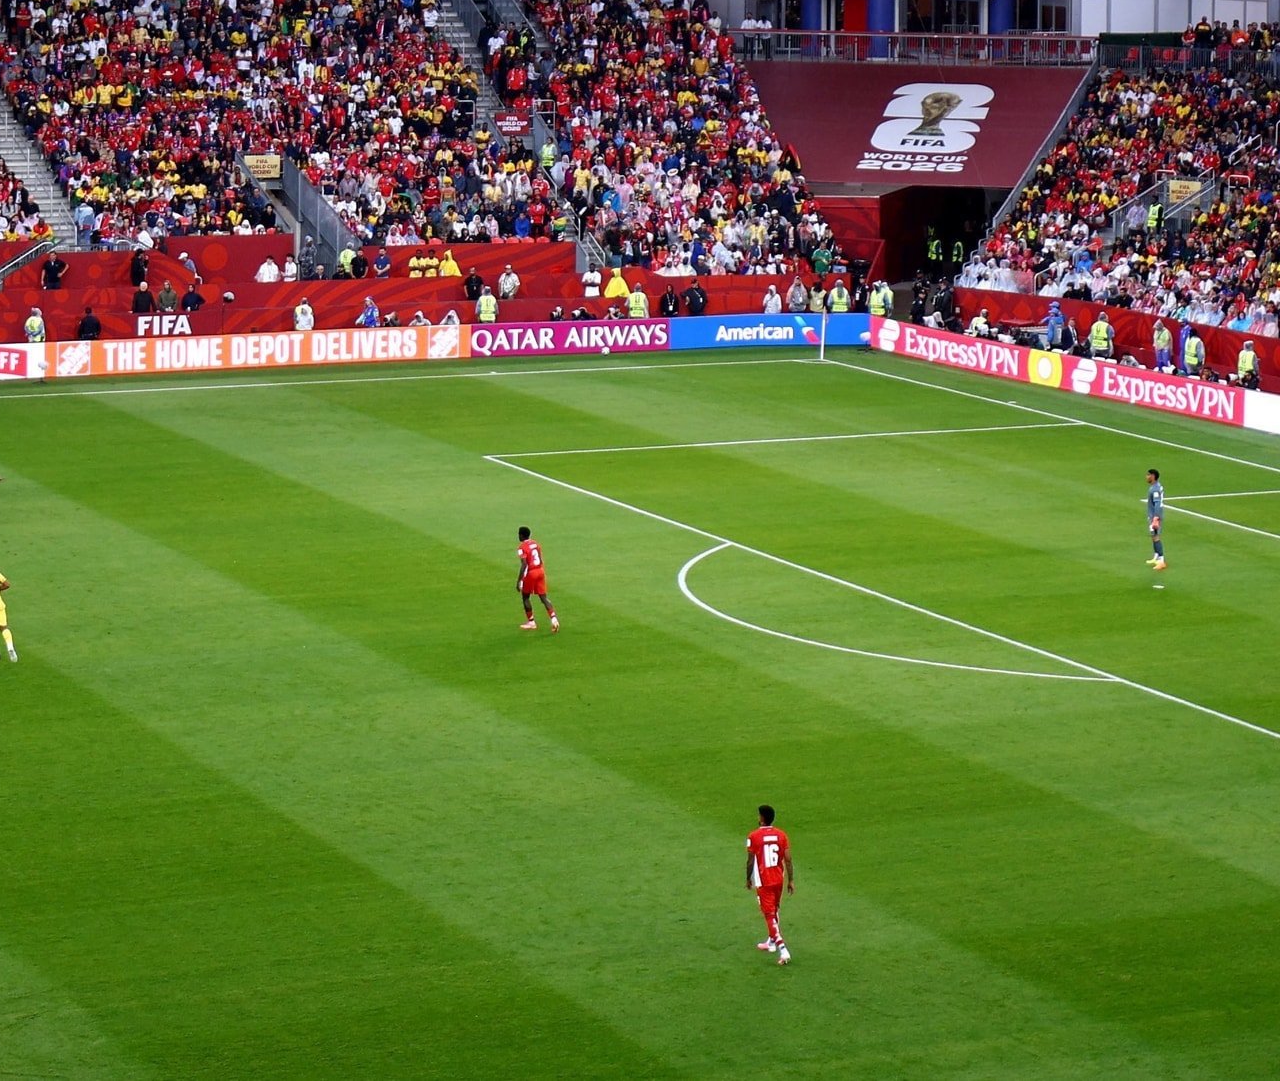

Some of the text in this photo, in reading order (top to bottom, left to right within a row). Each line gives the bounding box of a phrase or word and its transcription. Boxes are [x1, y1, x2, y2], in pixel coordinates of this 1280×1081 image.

[900, 138, 946, 148] FIFA
[856, 159, 965, 172] 2026
[863, 151, 969, 163] WORLD CUP
[137, 314, 192, 335] FIFA
[715, 323, 794, 342] American
[103, 340, 147, 372] THE
[154, 335, 223, 370] HOME
[231, 332, 304, 364] DEPOT
[311, 325, 417, 361] DELIVERS
[471, 327, 554, 356] QATAR
[564, 322, 668, 348] AIRWAYS
[904, 326, 1020, 376] ExpressVPN
[1103, 366, 1236, 420] ExpressVPN
[763, 844, 780, 868] 16
